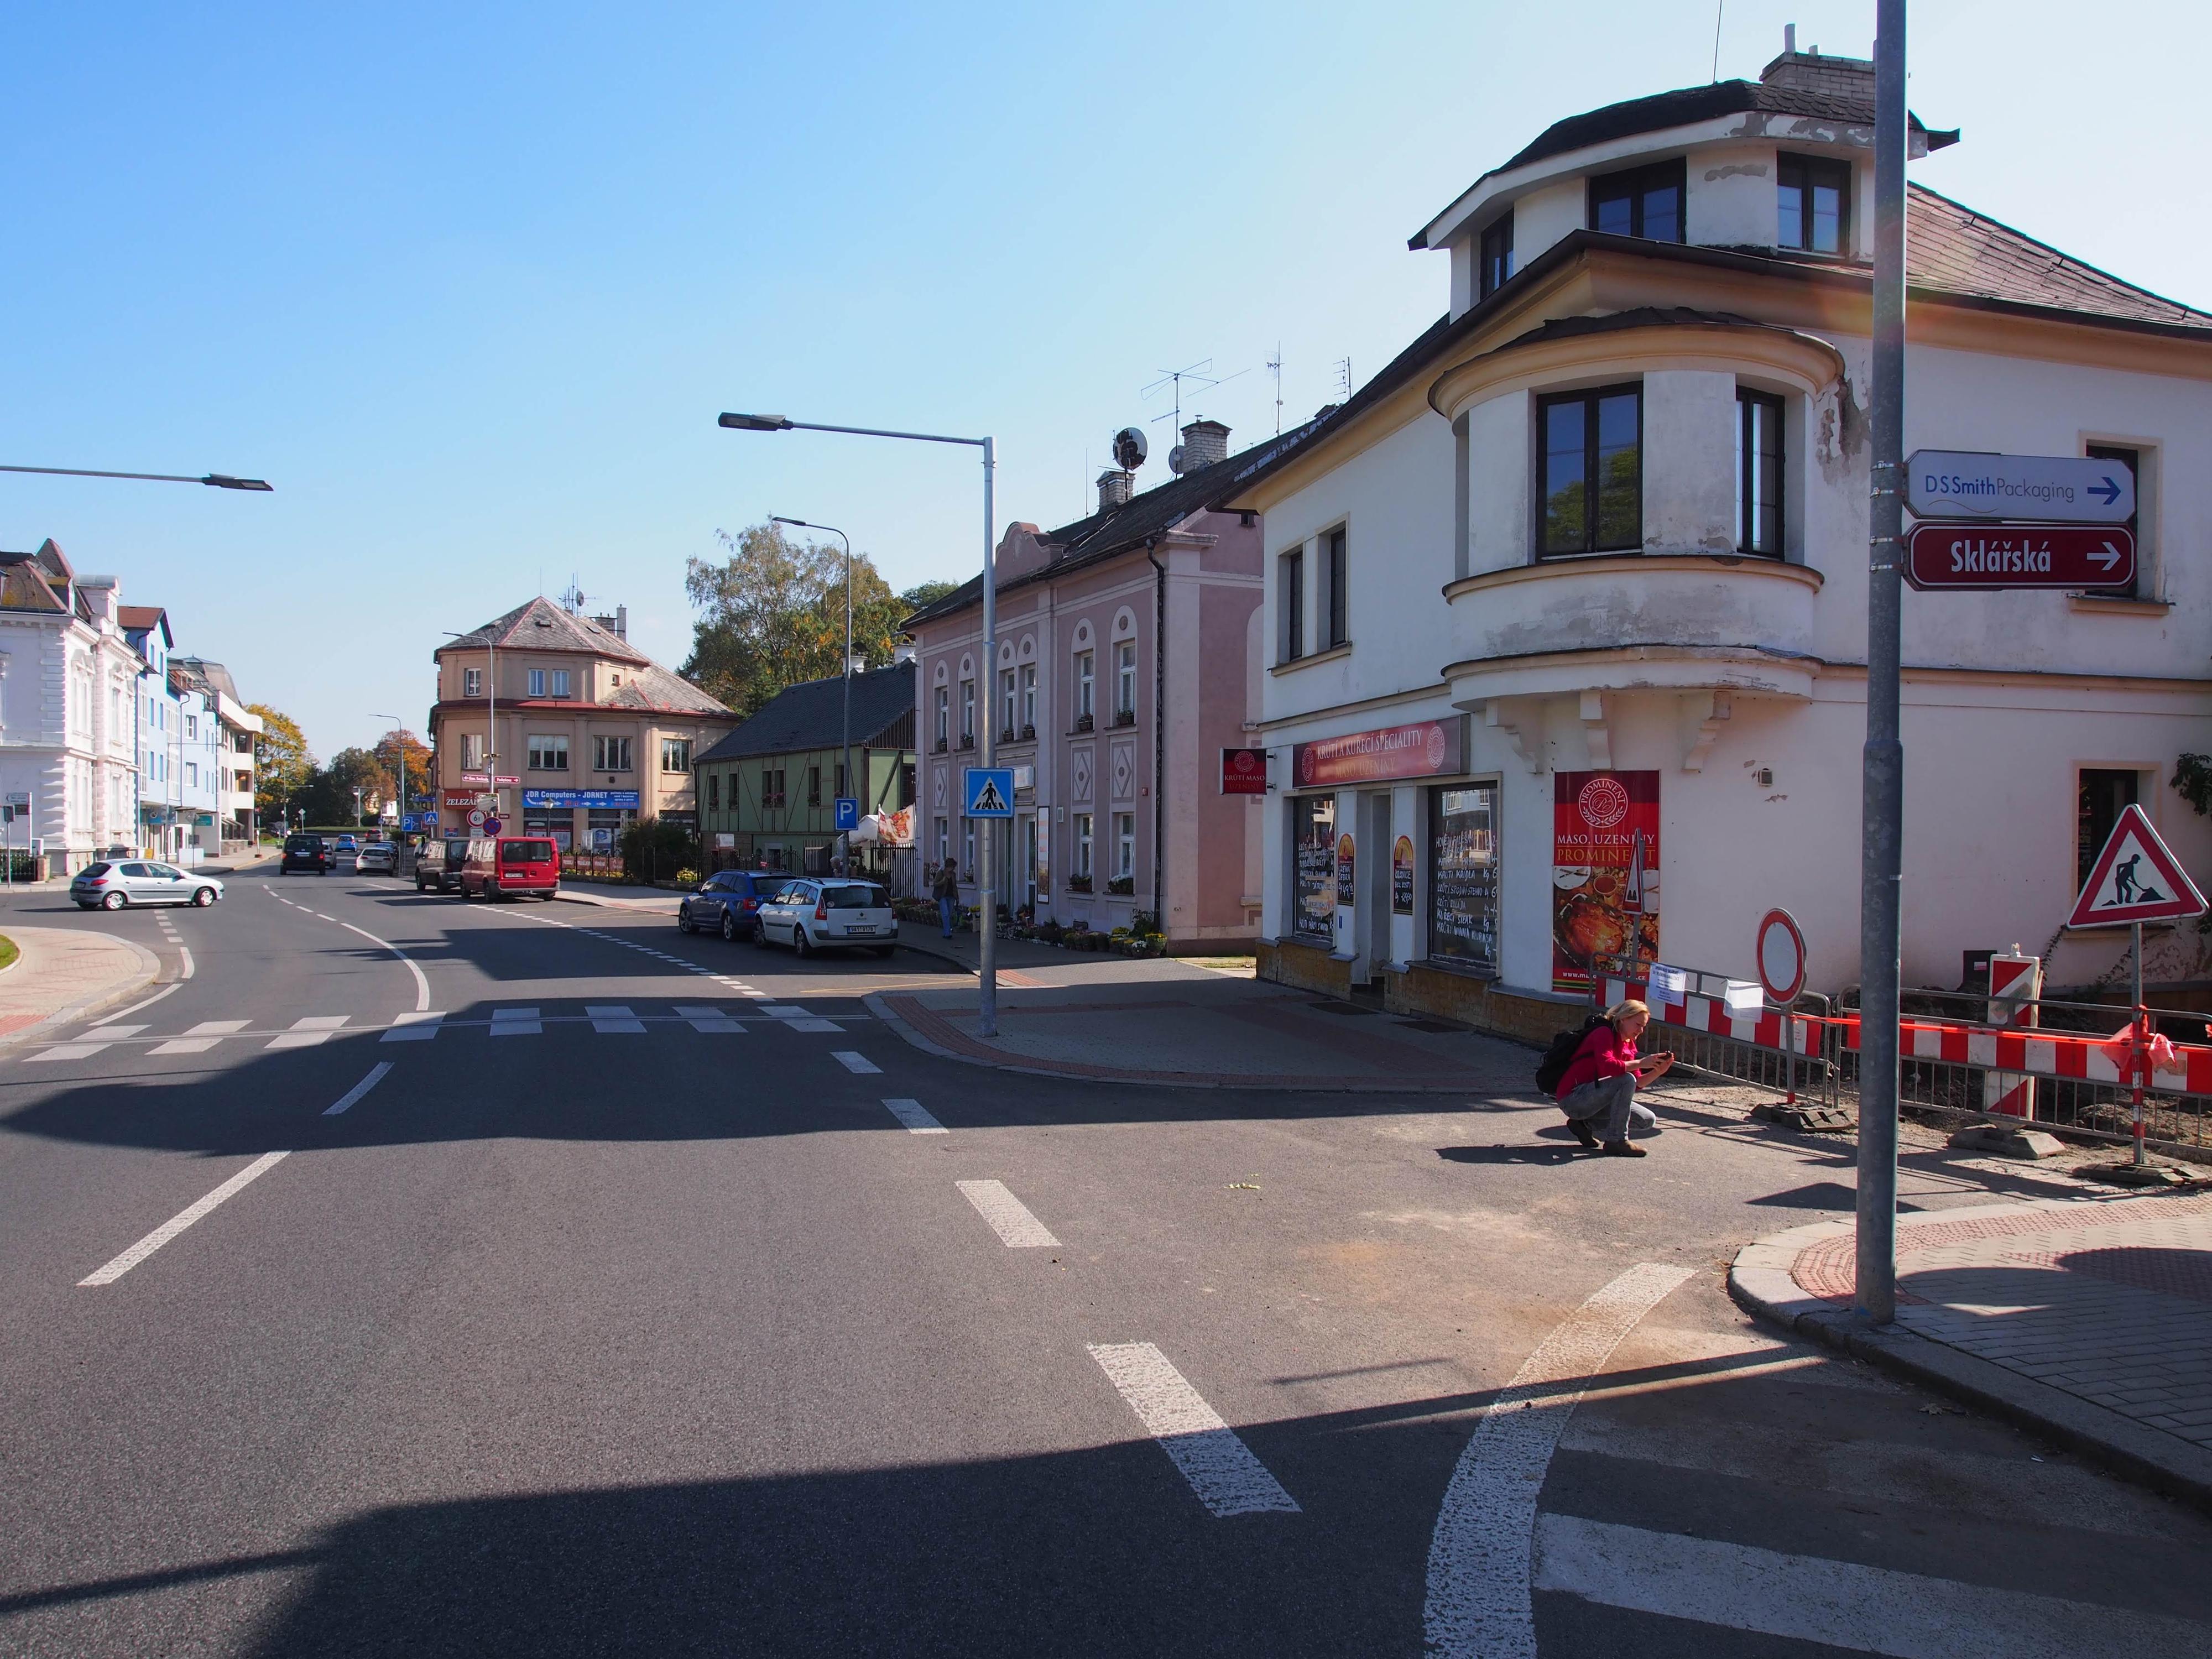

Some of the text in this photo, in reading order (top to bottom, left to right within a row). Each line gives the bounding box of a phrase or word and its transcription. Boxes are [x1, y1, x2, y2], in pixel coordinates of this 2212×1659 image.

[1950, 539, 2051, 573] Sklářská
[1339, 743, 1344, 757] A
[1345, 733, 1374, 756] KUŘECÍ
[1376, 729, 1422, 750] SPECIALITY
[1580, 780, 1626, 804] PROMINENT
[840, 802, 853, 821] P
[403, 818, 410, 827] P
[1557, 834, 1591, 845] MASO,
[1558, 849, 1656, 862] PROMINET
